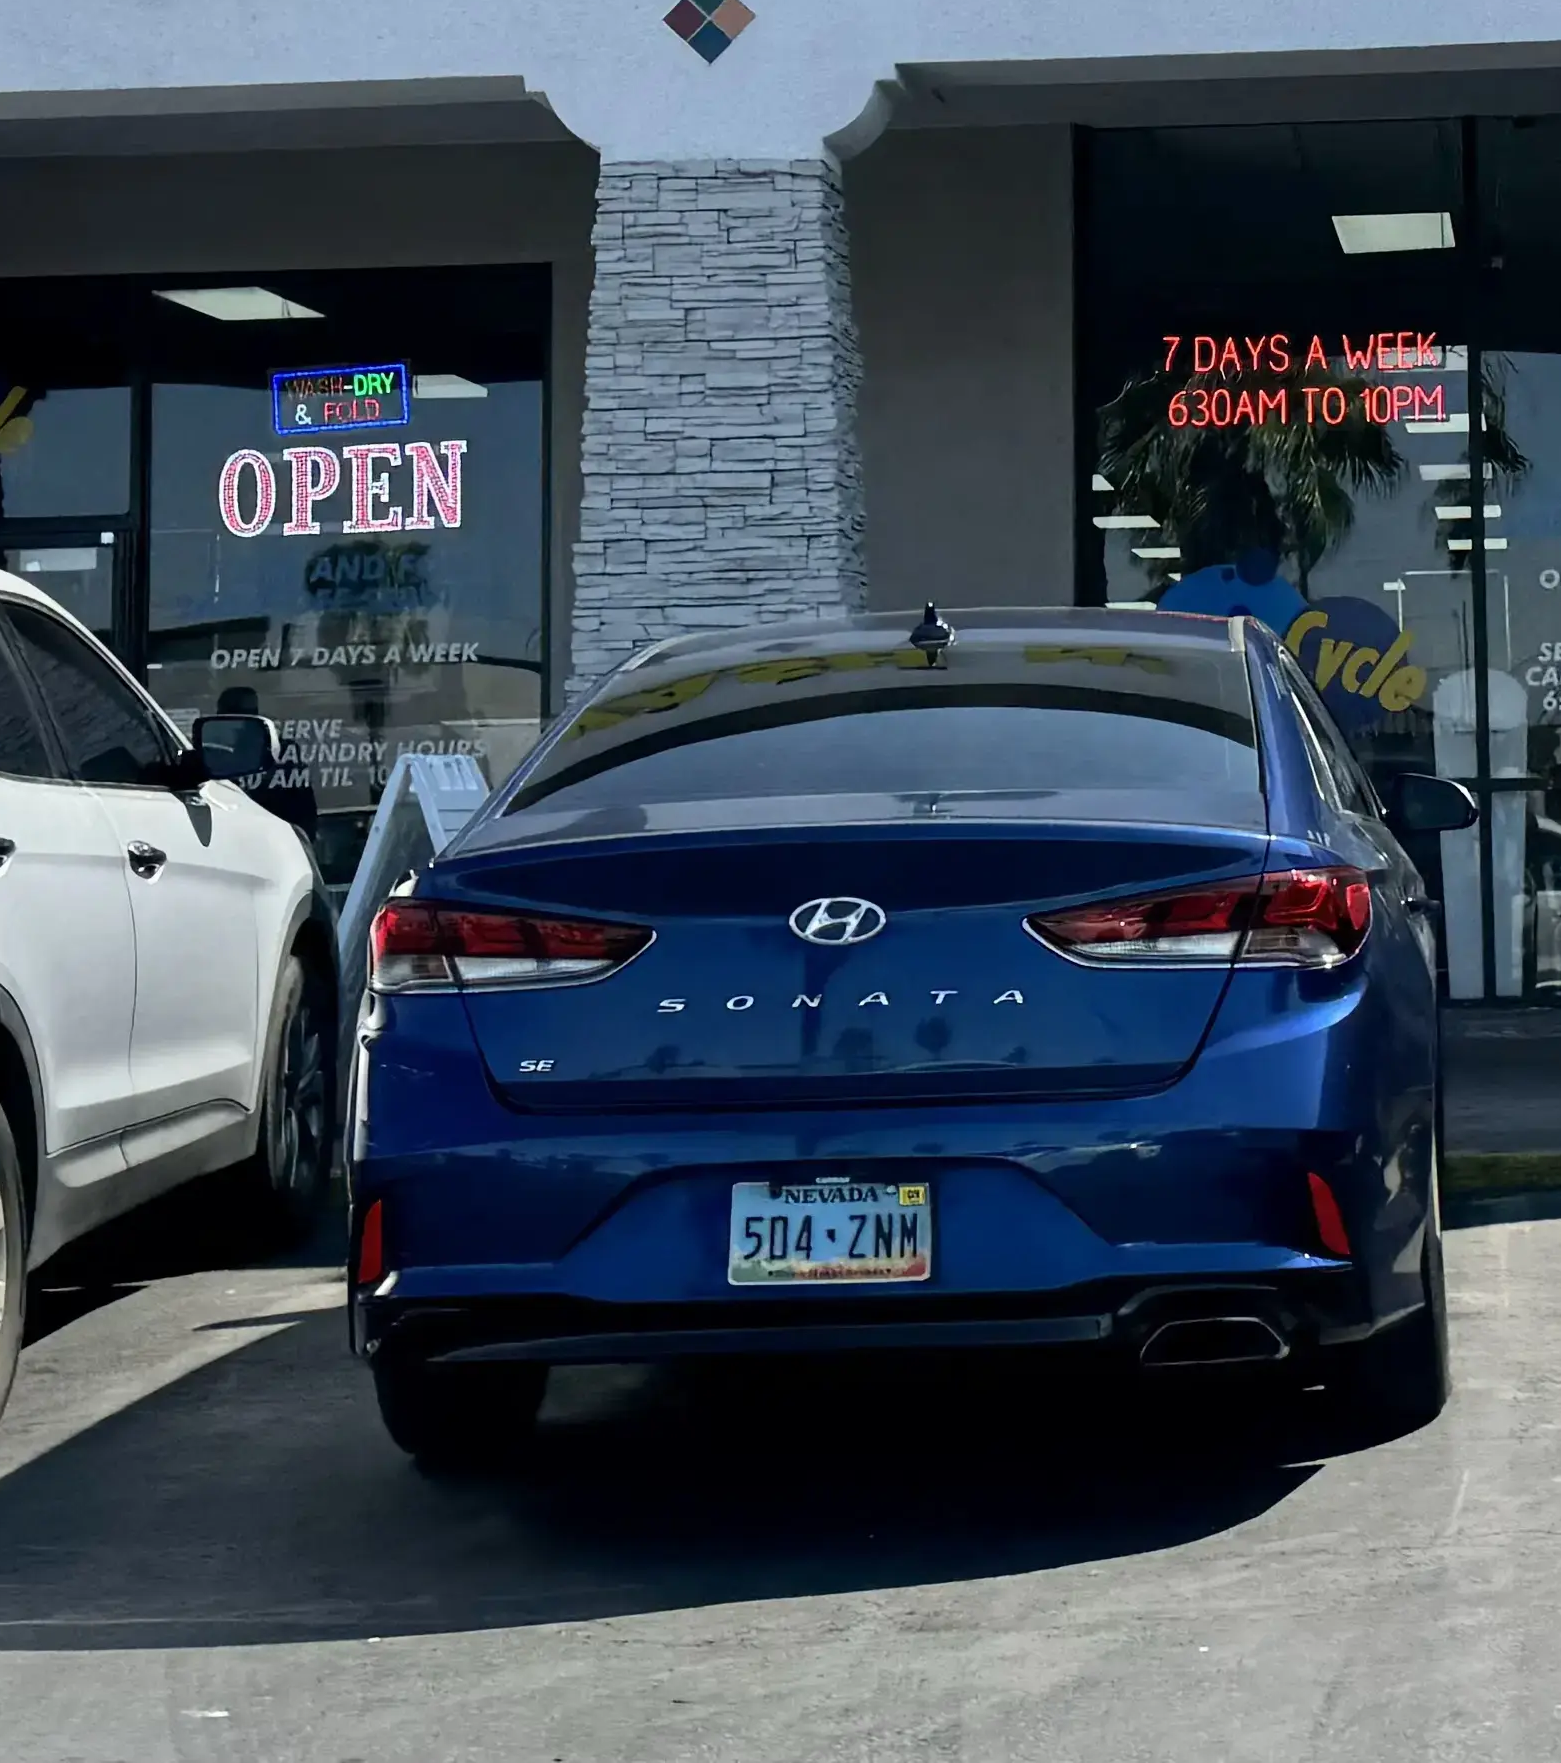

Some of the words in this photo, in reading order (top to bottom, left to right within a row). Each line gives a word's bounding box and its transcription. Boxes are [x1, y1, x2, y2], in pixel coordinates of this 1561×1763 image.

[1163, 335, 1182, 372] 7
[1192, 333, 1290, 373] DAYS
[1305, 333, 1328, 371] A
[1343, 331, 1440, 372] WEEK
[295, 403, 312, 426] &
[323, 398, 382, 425] FOLD
[1168, 387, 1288, 426] 630AM
[1301, 386, 1346, 425] TO
[1362, 384, 1447, 424] 10PM
[218, 440, 468, 538] OPEN
[211, 647, 281, 670] OPEN
[290, 648, 302, 667] 7
[312, 645, 376, 667] DAYS
[384, 644, 401, 664] A
[409, 642, 479, 664] WEEK
[277, 740, 388, 765] AUNDRY
[269, 768, 311, 789] AM
[319, 767, 354, 789] TIL
[657, 988, 1025, 1014] SONATA
[518, 1059, 555, 1073] SE
[784, 1186, 880, 1205] NEVADA
